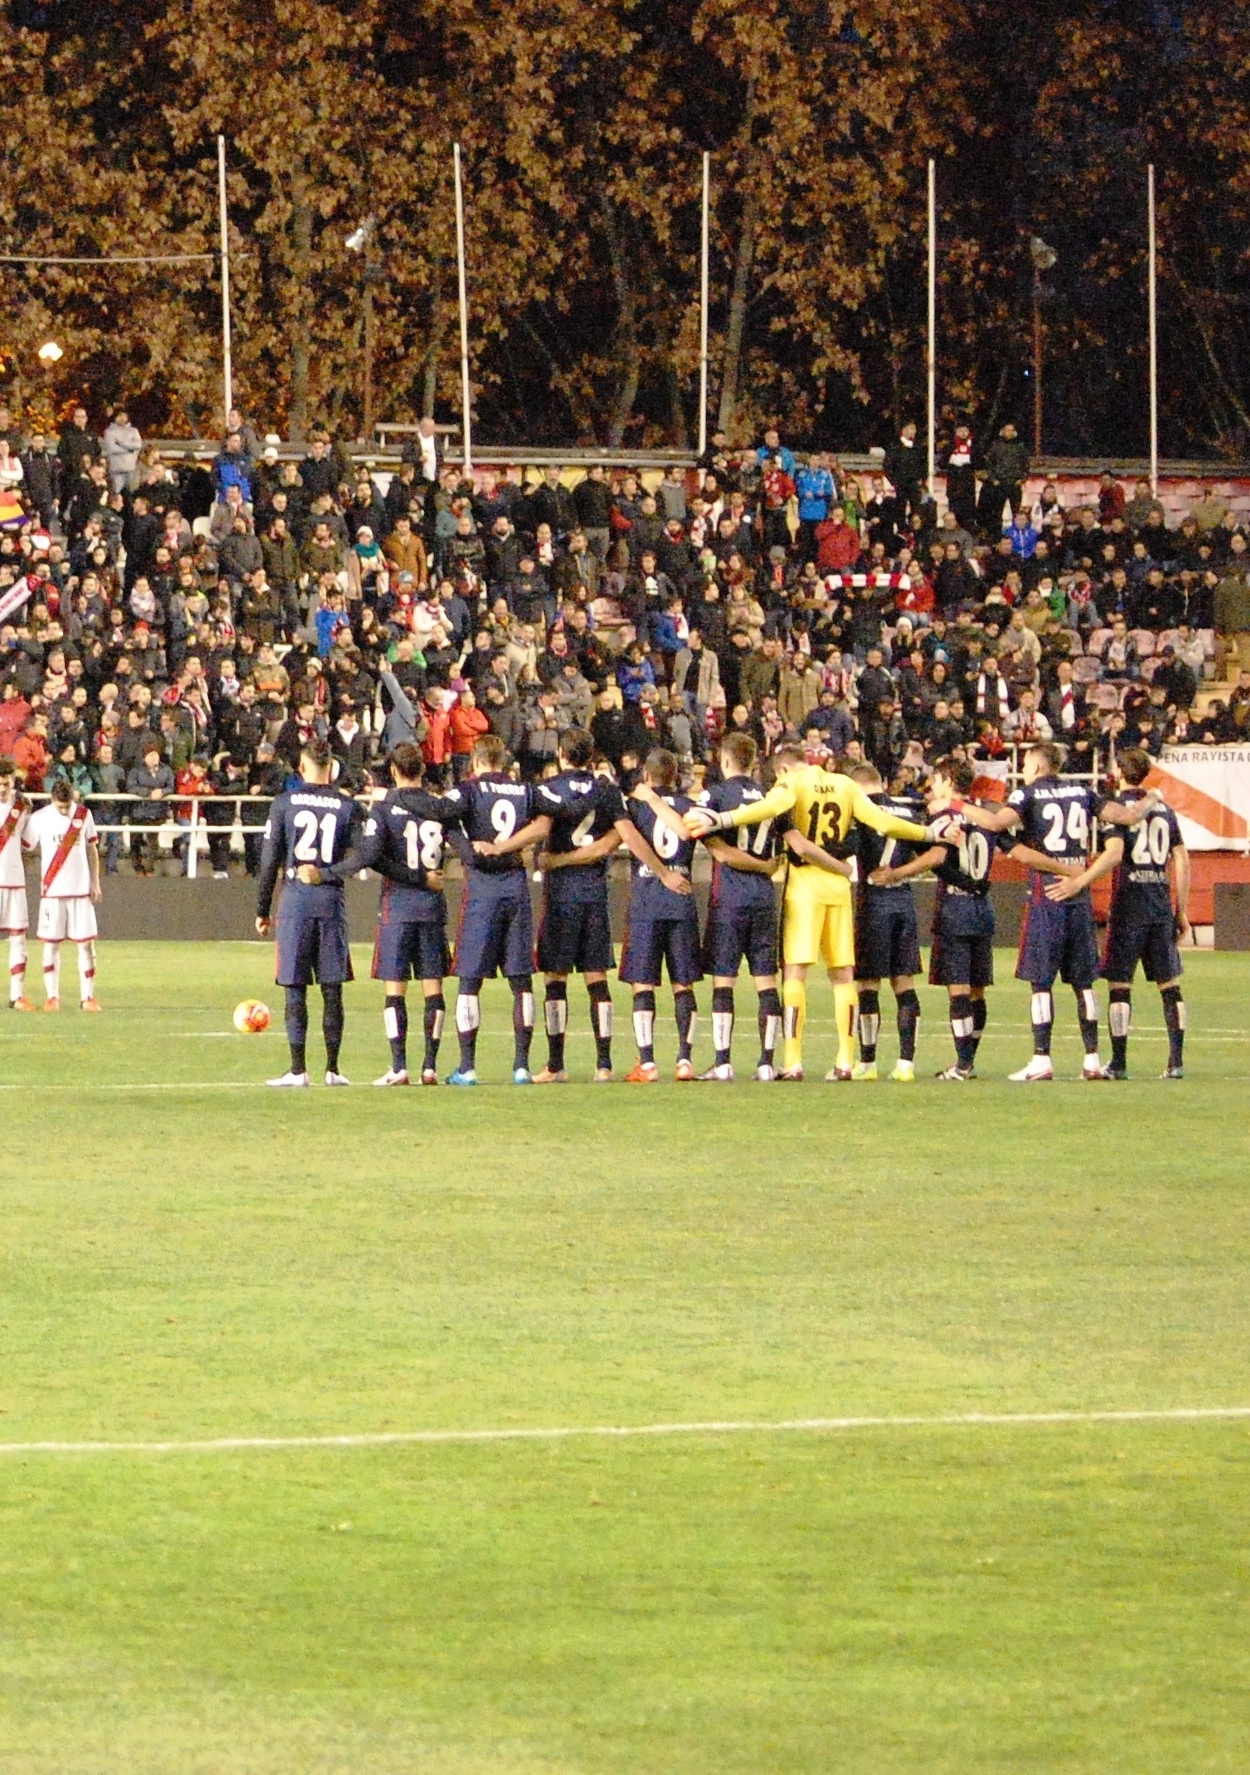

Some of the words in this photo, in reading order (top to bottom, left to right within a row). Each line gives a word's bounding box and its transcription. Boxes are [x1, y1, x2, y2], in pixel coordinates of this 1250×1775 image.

[1192, 751, 1245, 763] RAYISTA
[293, 810, 337, 864] 21
[403, 819, 443, 870] 18
[490, 798, 517, 845] 9
[652, 817, 679, 859] 6
[806, 800, 842, 846] 13
[1042, 801, 1089, 852] 24
[1130, 816, 1170, 866] 20
